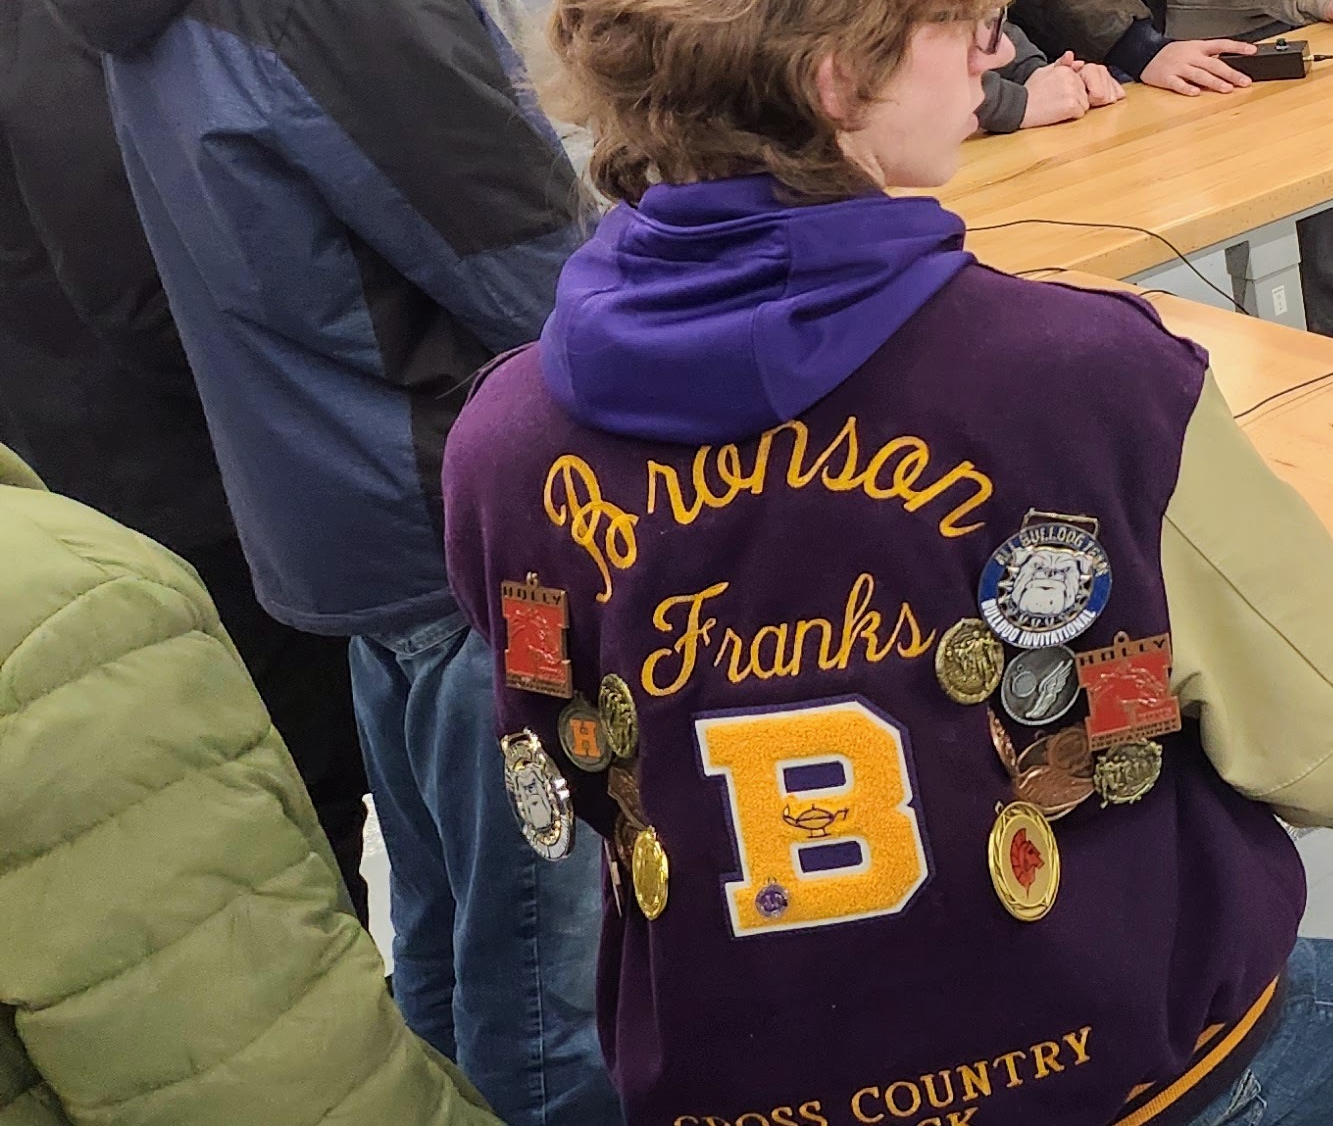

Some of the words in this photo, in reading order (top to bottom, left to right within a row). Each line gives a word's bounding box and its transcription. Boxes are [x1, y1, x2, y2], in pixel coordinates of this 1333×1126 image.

[543, 415, 994, 603] Bronson
[641, 572, 937, 697] Franks
[981, 598, 1018, 642] BULLDOG
[1019, 609, 1097, 646] INVITATIONAL
[570, 719, 600, 759] H
[695, 701, 929, 938] B
[850, 1025, 1093, 1125] COUNTRY
